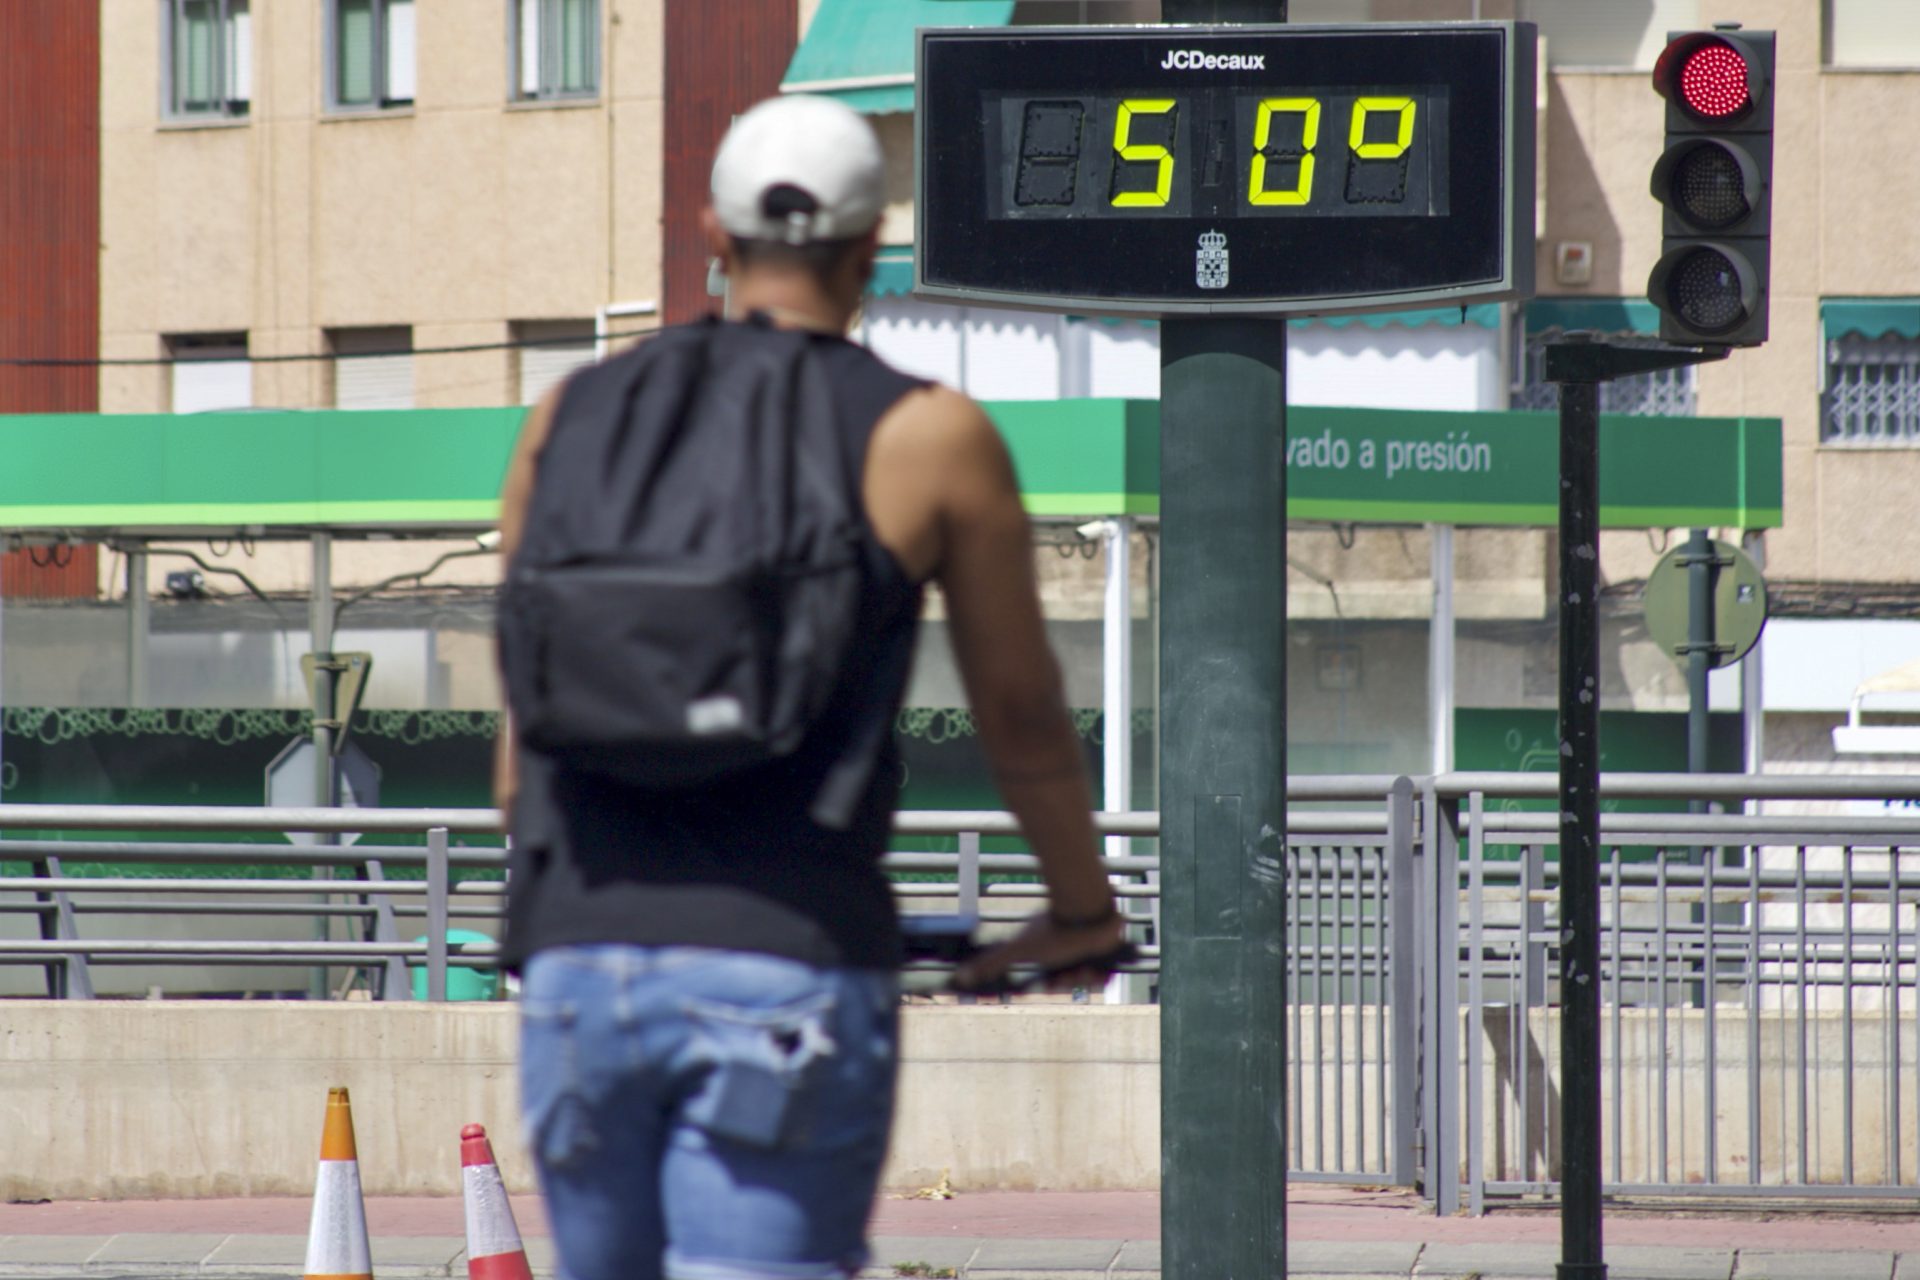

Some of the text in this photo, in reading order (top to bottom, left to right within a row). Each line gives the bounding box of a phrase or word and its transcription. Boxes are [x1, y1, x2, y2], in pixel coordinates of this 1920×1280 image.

[1161, 50, 1265, 70] JCDecaux
[1359, 438, 1376, 469] a
[1386, 431, 1491, 479] presión
